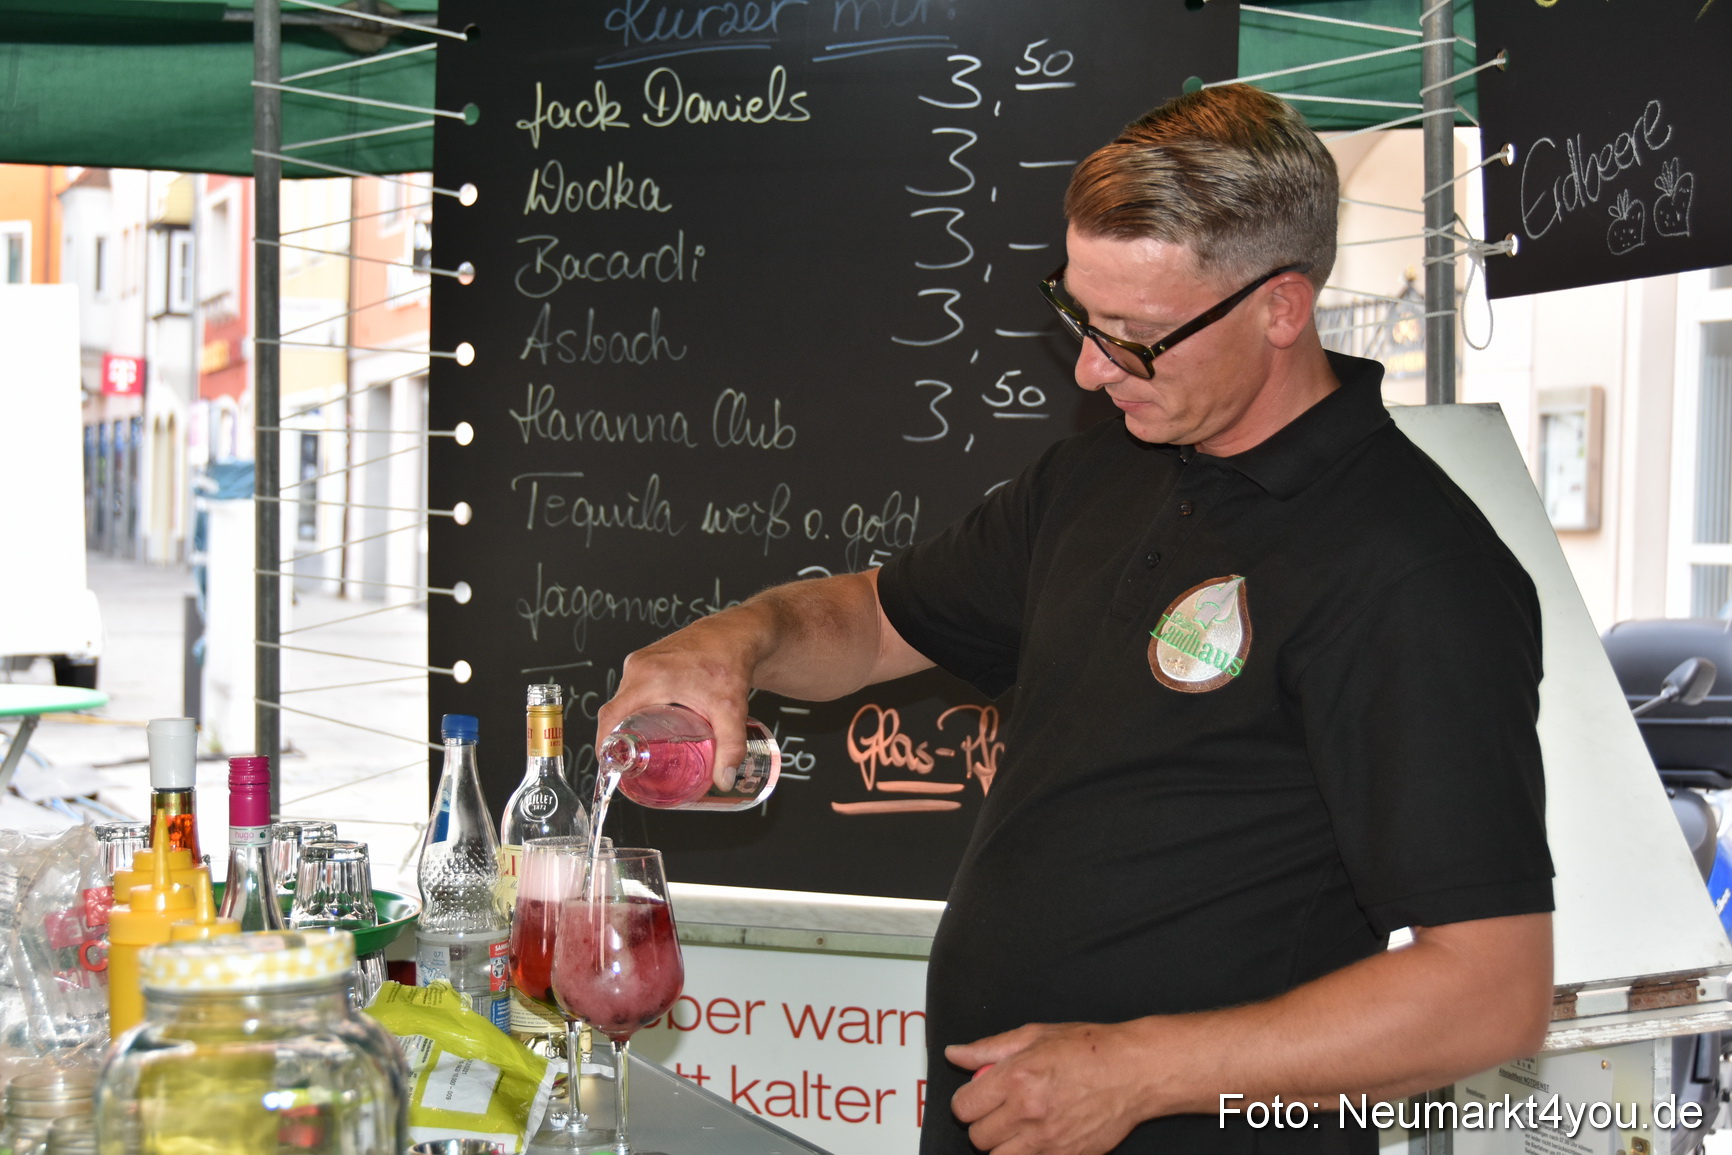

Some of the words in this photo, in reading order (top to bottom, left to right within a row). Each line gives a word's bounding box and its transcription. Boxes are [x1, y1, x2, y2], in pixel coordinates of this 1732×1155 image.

[516, 79, 630, 149] Jack
[642, 65, 811, 127] Daniels
[523, 159, 672, 215] Wodka
[1521, 99, 1673, 240] Erdbeere
[515, 229, 706, 298] Bacardi
[519, 301, 687, 365] Asbach
[713, 388, 796, 449] Club
[512, 472, 687, 548] Tequila
[701, 482, 791, 556] weiß
[842, 490, 920, 572] gold
[1149, 613, 1244, 677] Landhaus
[847, 703, 1005, 797] Glas-Pf
[234, 830, 255, 841] hugo
[643, 994, 766, 1035] ber
[731, 1064, 897, 1125] kalter
